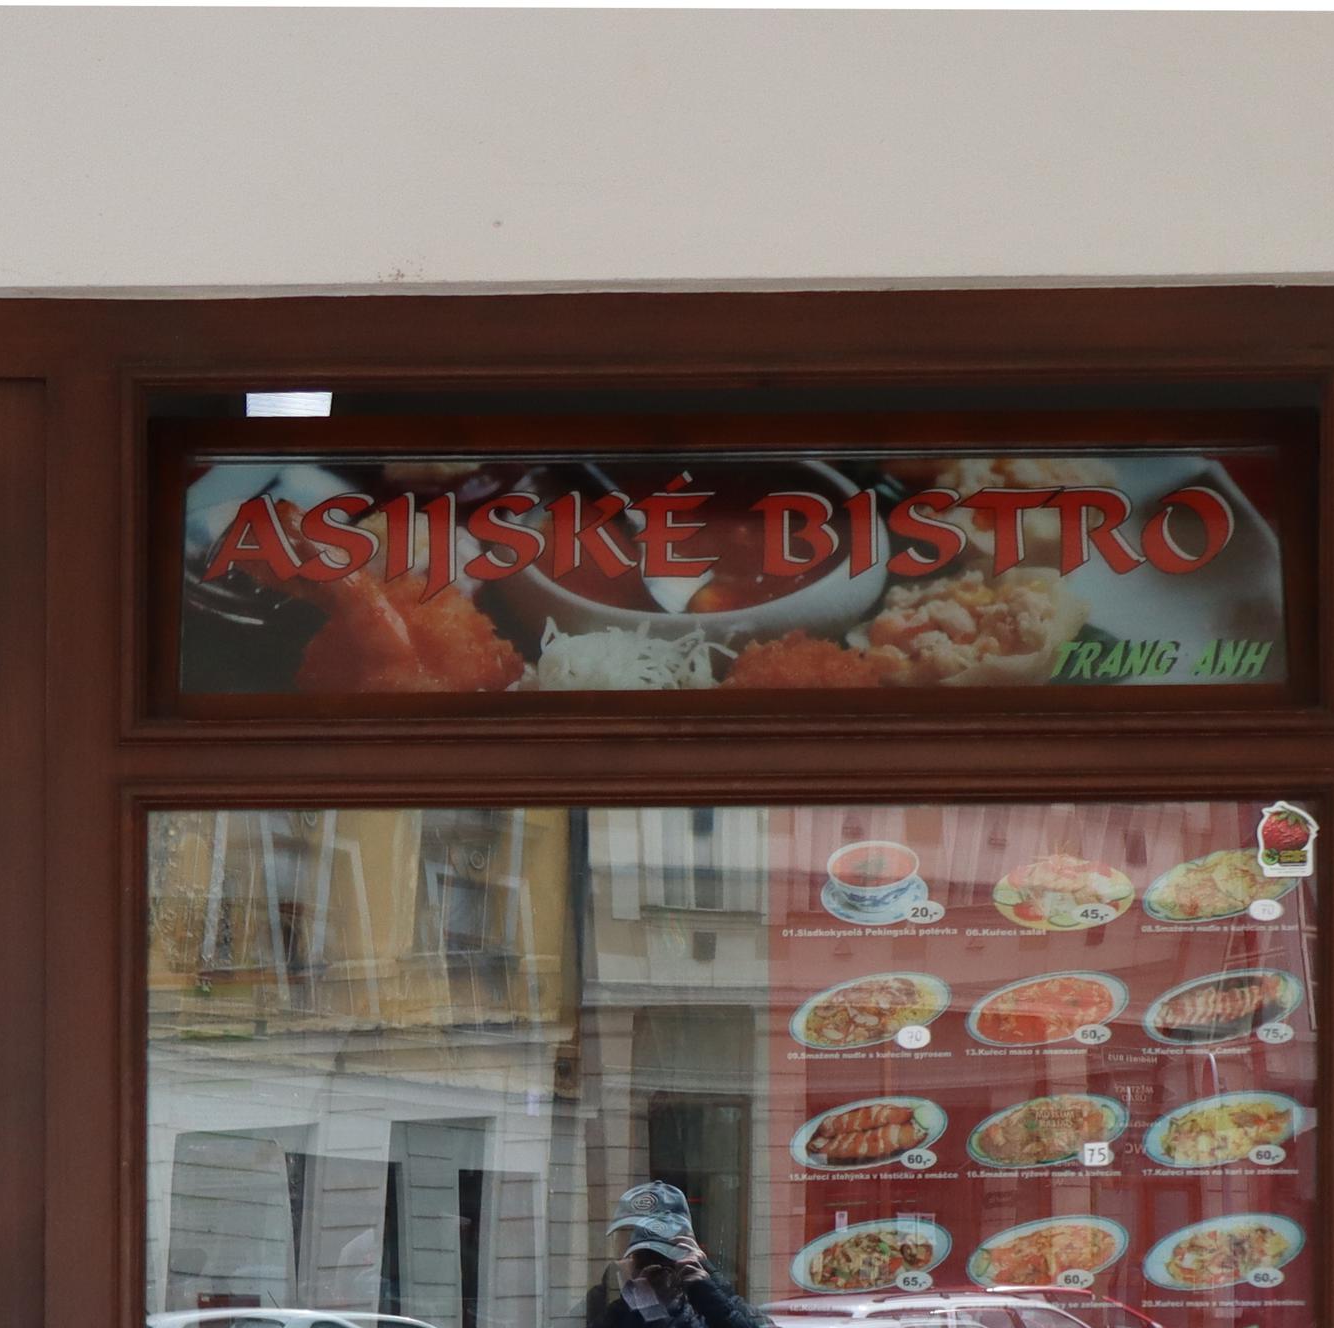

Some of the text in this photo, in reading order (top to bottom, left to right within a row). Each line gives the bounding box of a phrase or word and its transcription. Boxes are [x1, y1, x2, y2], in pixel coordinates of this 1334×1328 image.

[201, 472, 1236, 604] ASIJSKÉ BISTRO
[1049, 639, 1275, 678] TRANG ANH
[910, 906, 938, 920] 20,-
[1080, 909, 1109, 920] 45,-
[906, 1154, 931, 1166] 60,-
[1087, 1147, 1107, 1163] 75
[1255, 1150, 1280, 1162] 60,-
[902, 1276, 927, 1288] 65,-
